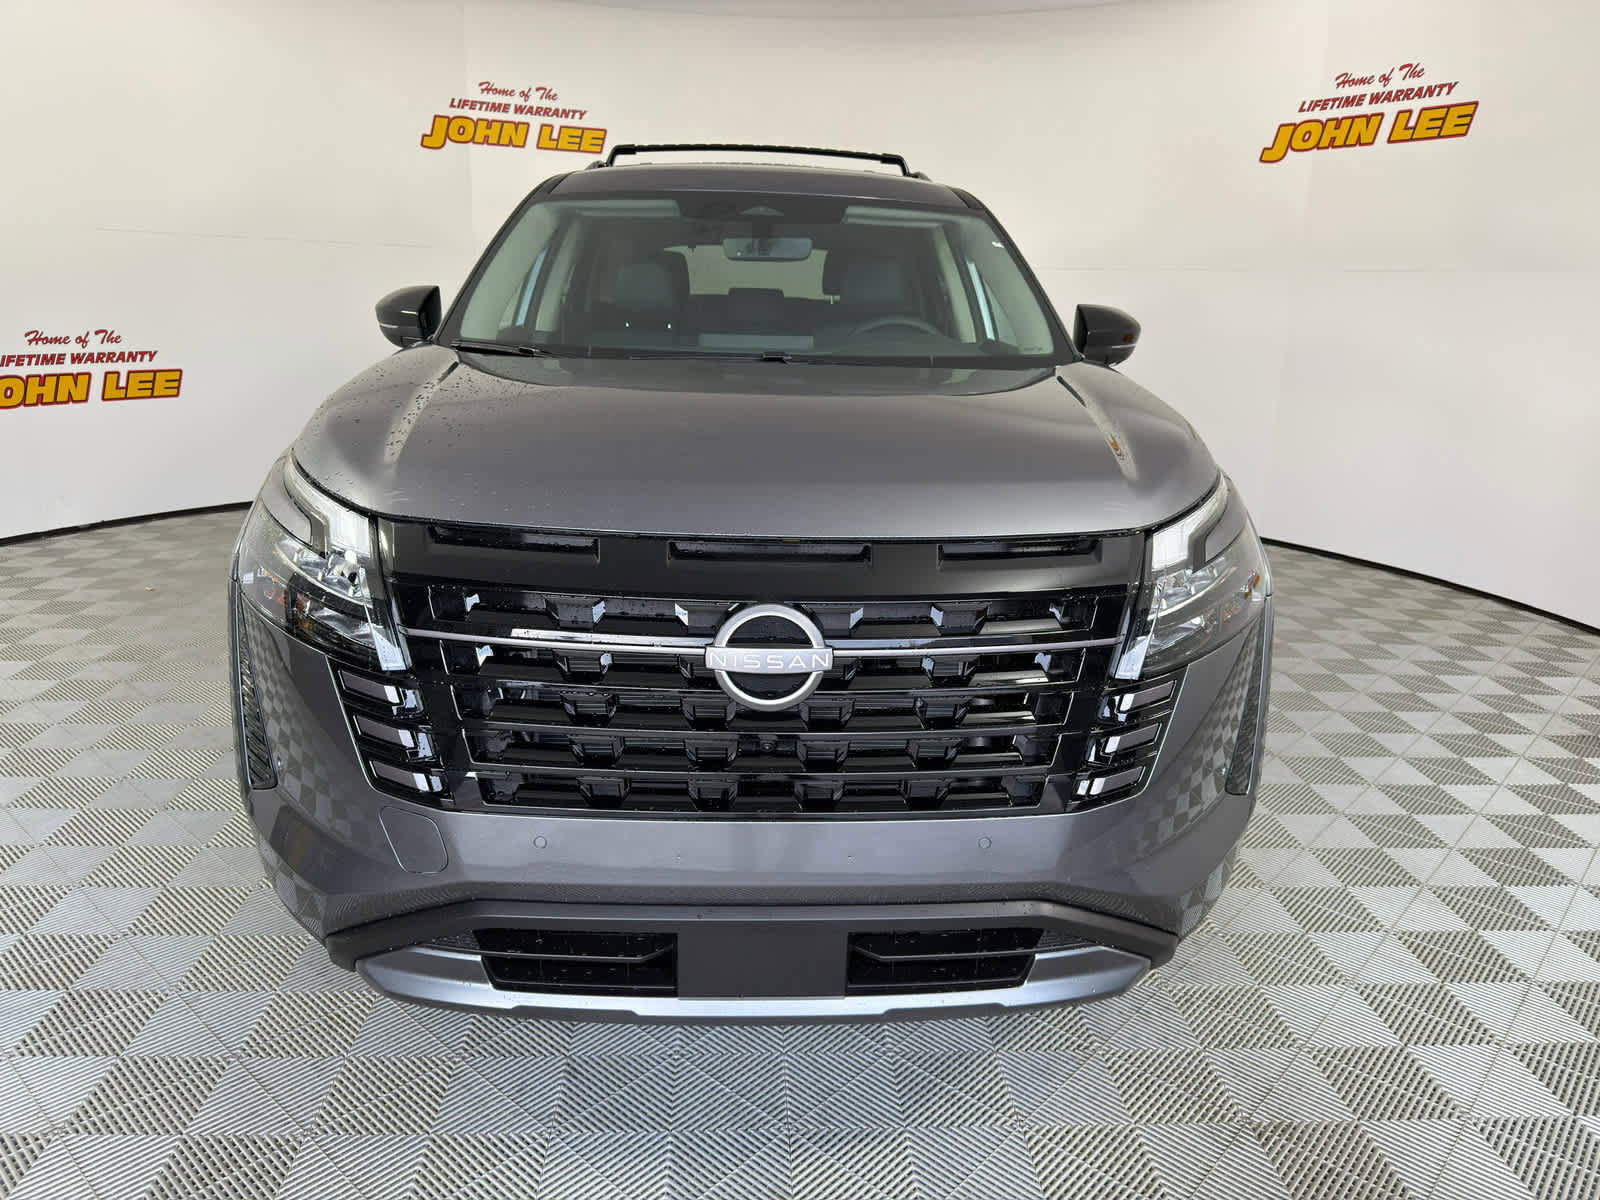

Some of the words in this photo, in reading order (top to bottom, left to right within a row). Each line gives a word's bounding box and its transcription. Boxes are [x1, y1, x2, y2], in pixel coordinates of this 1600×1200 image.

[1335, 72, 1376, 89] Home
[1378, 67, 1395, 84] of
[1398, 63, 1425, 80] The
[478, 81, 516, 98] Home
[519, 87, 531, 102] of
[535, 87, 558, 101] The
[1298, 93, 1367, 113] LIFETIME
[1369, 81, 1459, 105] WARRANTY
[449, 97, 511, 113] LIFETIME
[514, 105, 587, 120] WARRANTY
[420, 114, 530, 150] JOHN
[536, 123, 607, 154] LEE
[1259, 112, 1385, 163] JOHN
[1387, 101, 1479, 144] LEE
[24, 329, 71, 346] Home
[75, 331, 90, 349] of
[94, 329, 122, 345] The
[0, 353, 67, 368] IFETIME
[70, 350, 158, 366] WARRANTY
[0, 371, 92, 410] OHN
[101, 368, 183, 402] LEE
[709, 653, 829, 669] NISSAN
